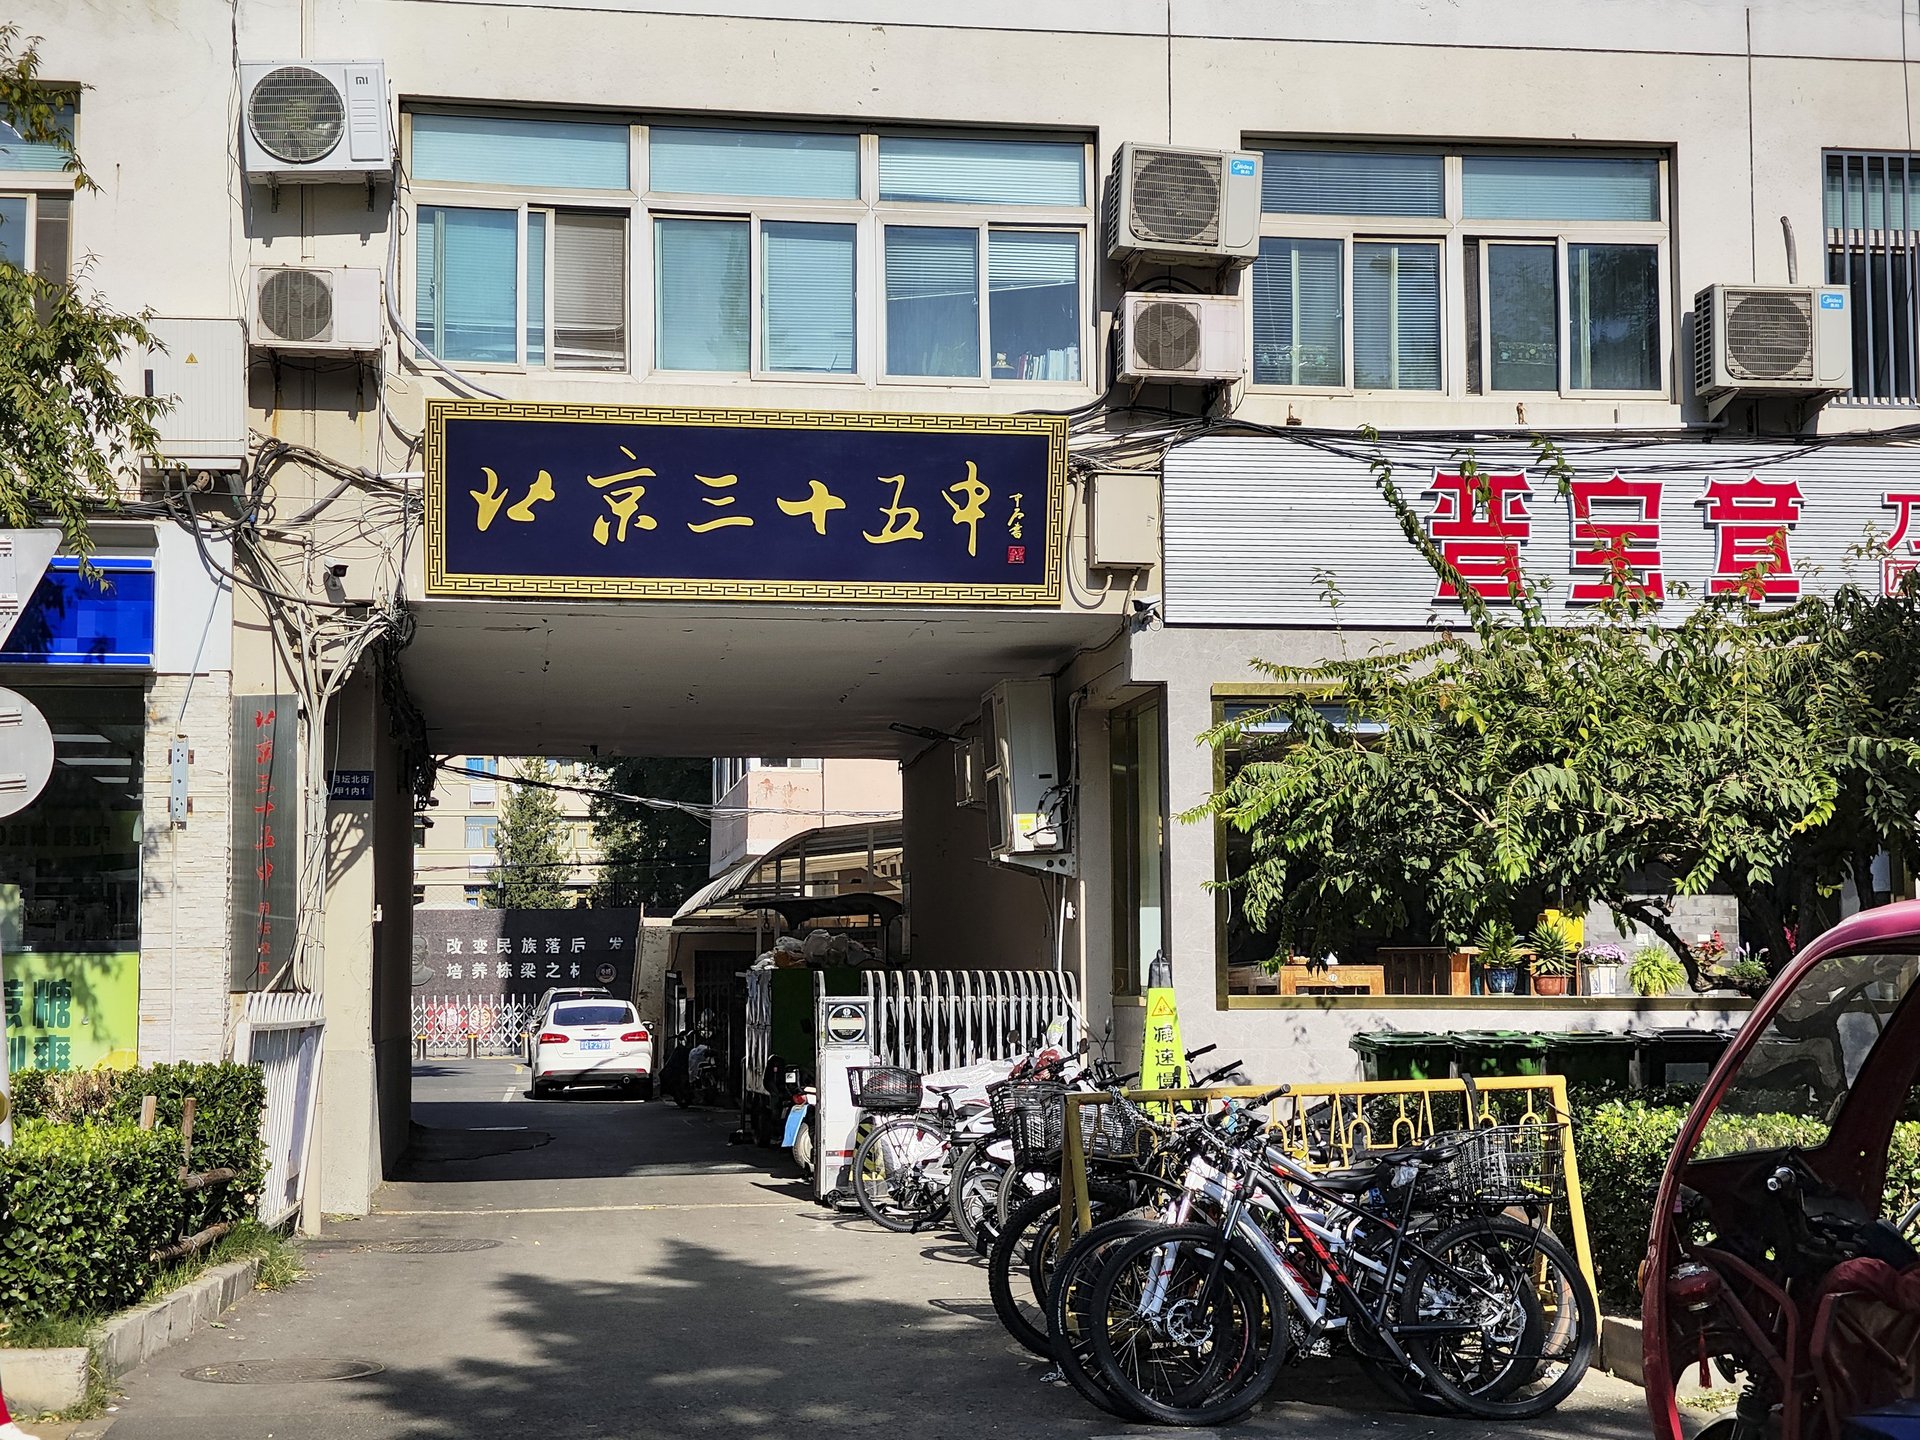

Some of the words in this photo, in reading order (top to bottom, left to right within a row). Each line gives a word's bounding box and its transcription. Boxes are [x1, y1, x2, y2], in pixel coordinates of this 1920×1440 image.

[469, 446, 991, 557] 北京三十五中
[446, 937, 587, 955] 改变民族落后
